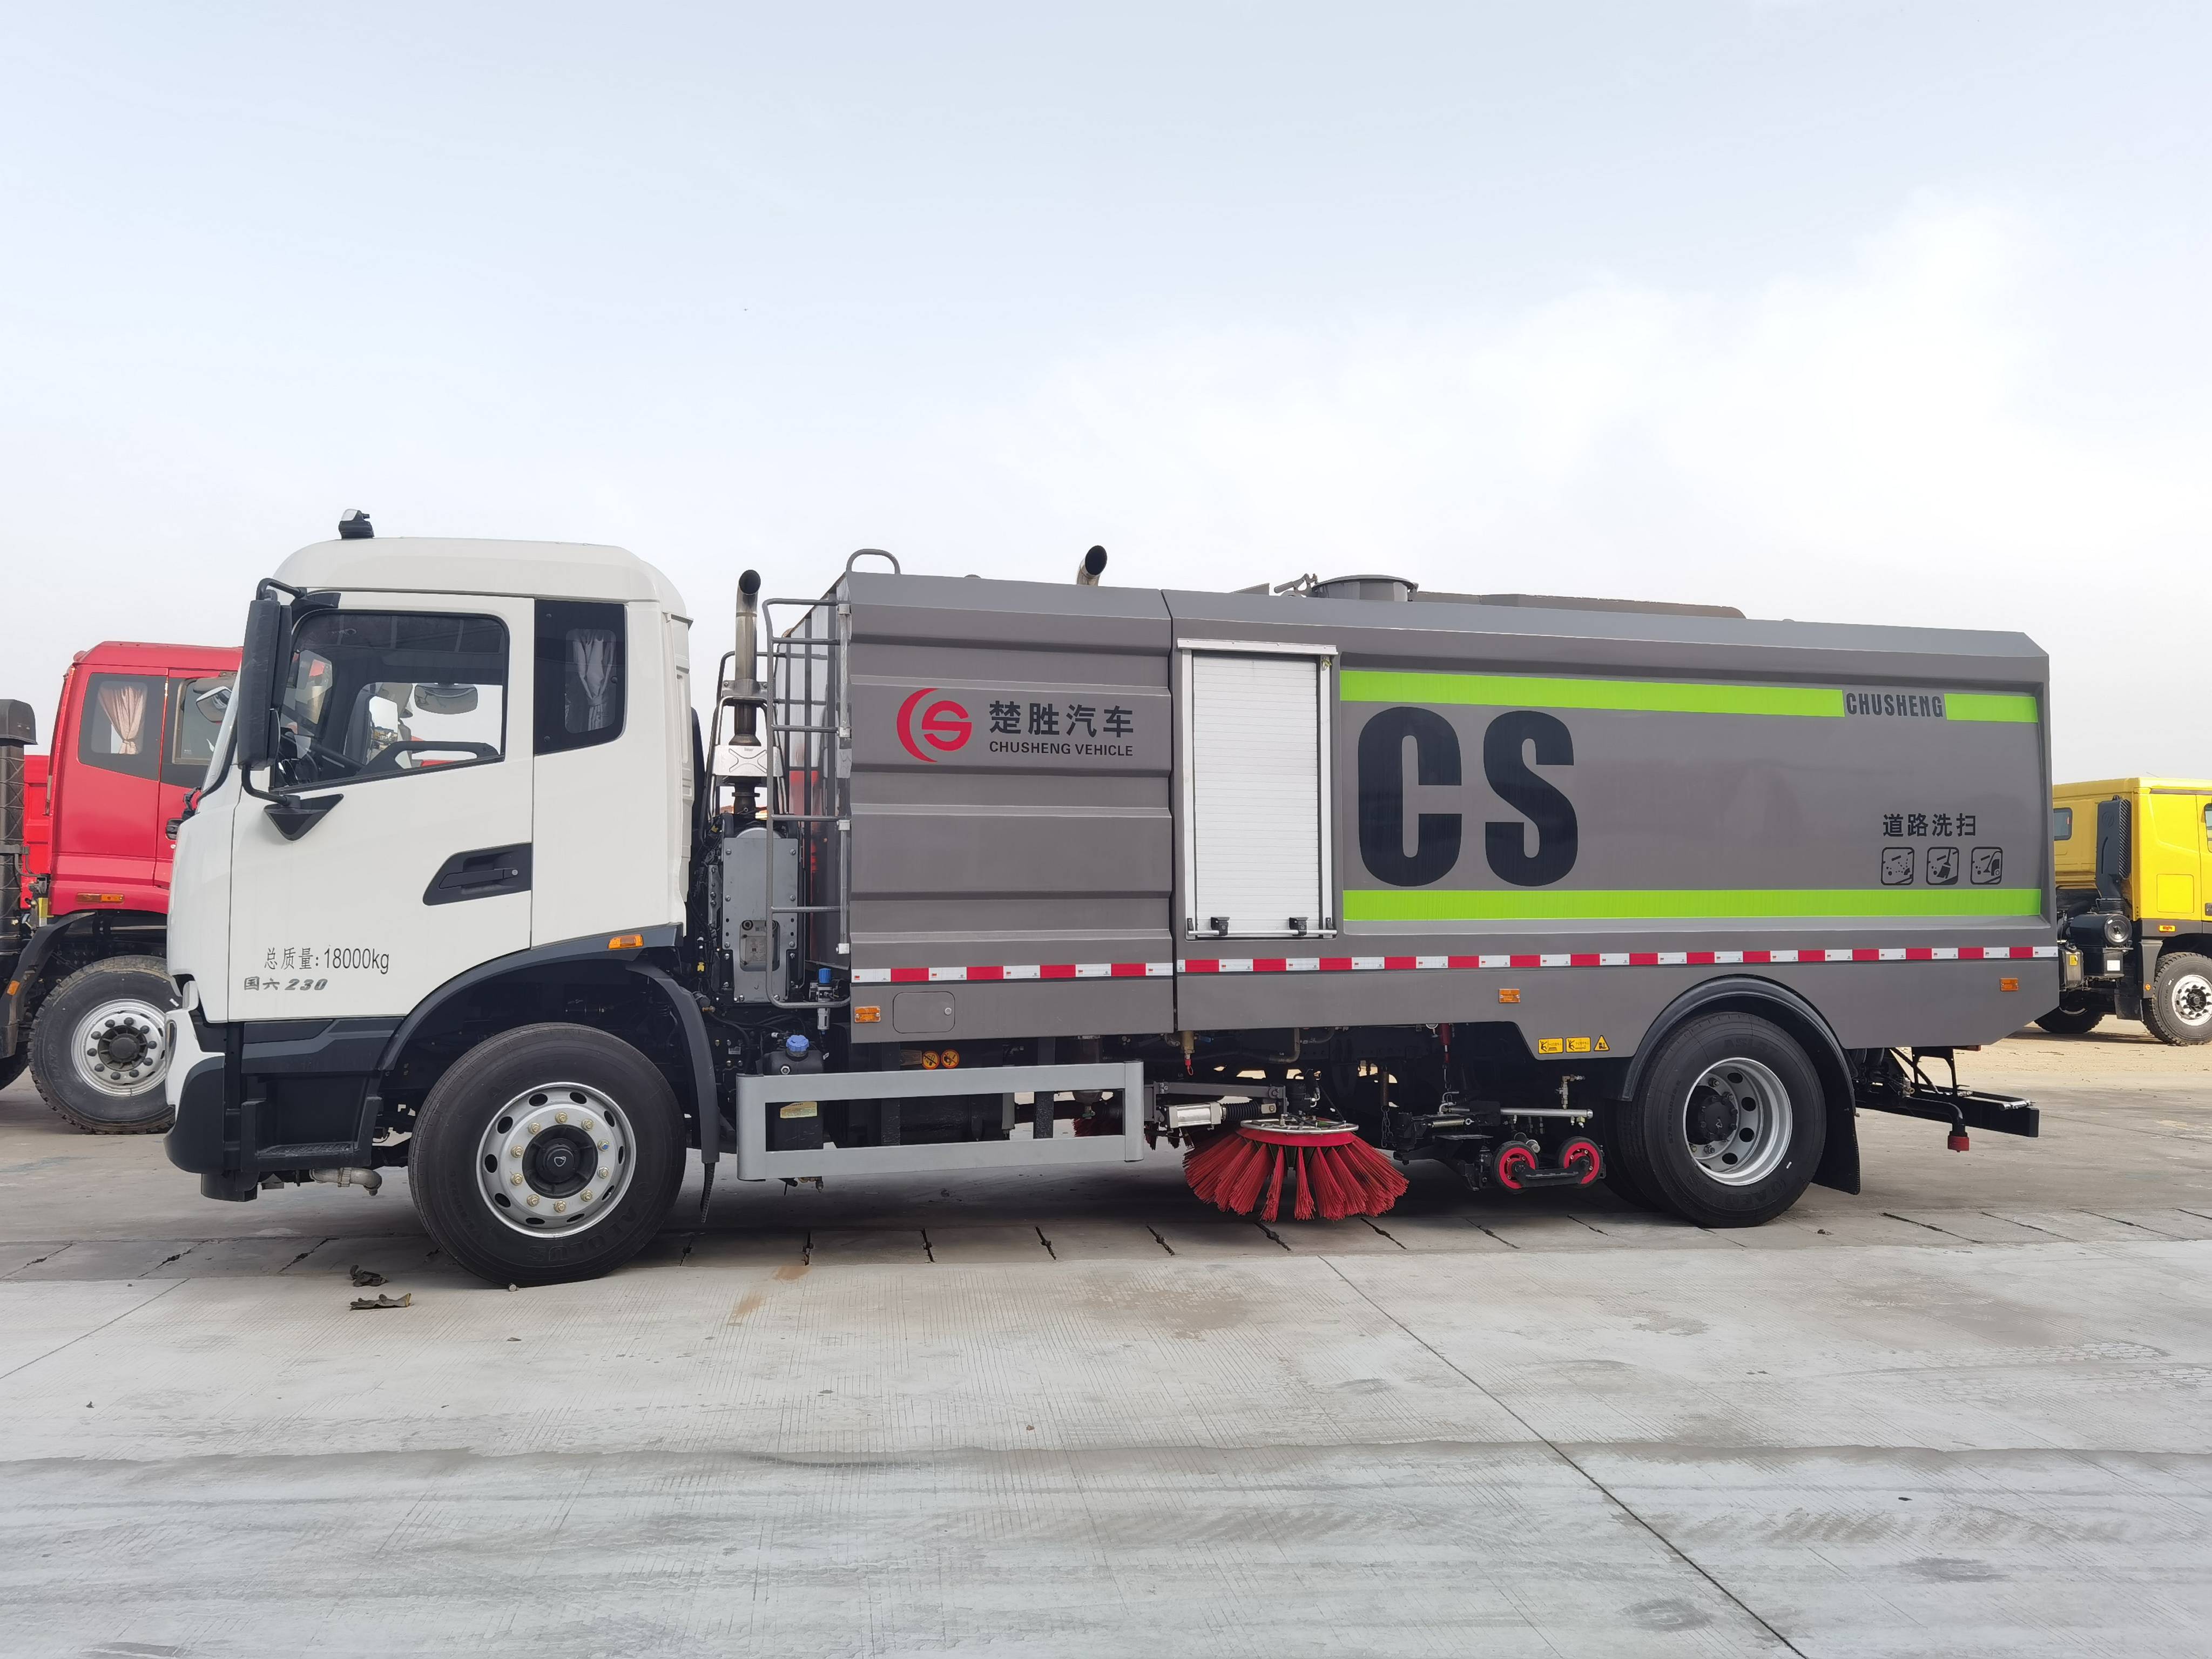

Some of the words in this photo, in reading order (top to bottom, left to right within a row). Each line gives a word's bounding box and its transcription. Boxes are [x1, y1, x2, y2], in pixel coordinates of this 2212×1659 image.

[1846, 692, 1944, 718] CHUSHENG
[989, 700, 1134, 738] 楚胜汽车
[989, 741, 1071, 755] CHUSHENG
[1075, 744, 1134, 756] VEHICLE
[1358, 706, 1578, 886] CS
[1883, 813, 1977, 837] 道路洗扫
